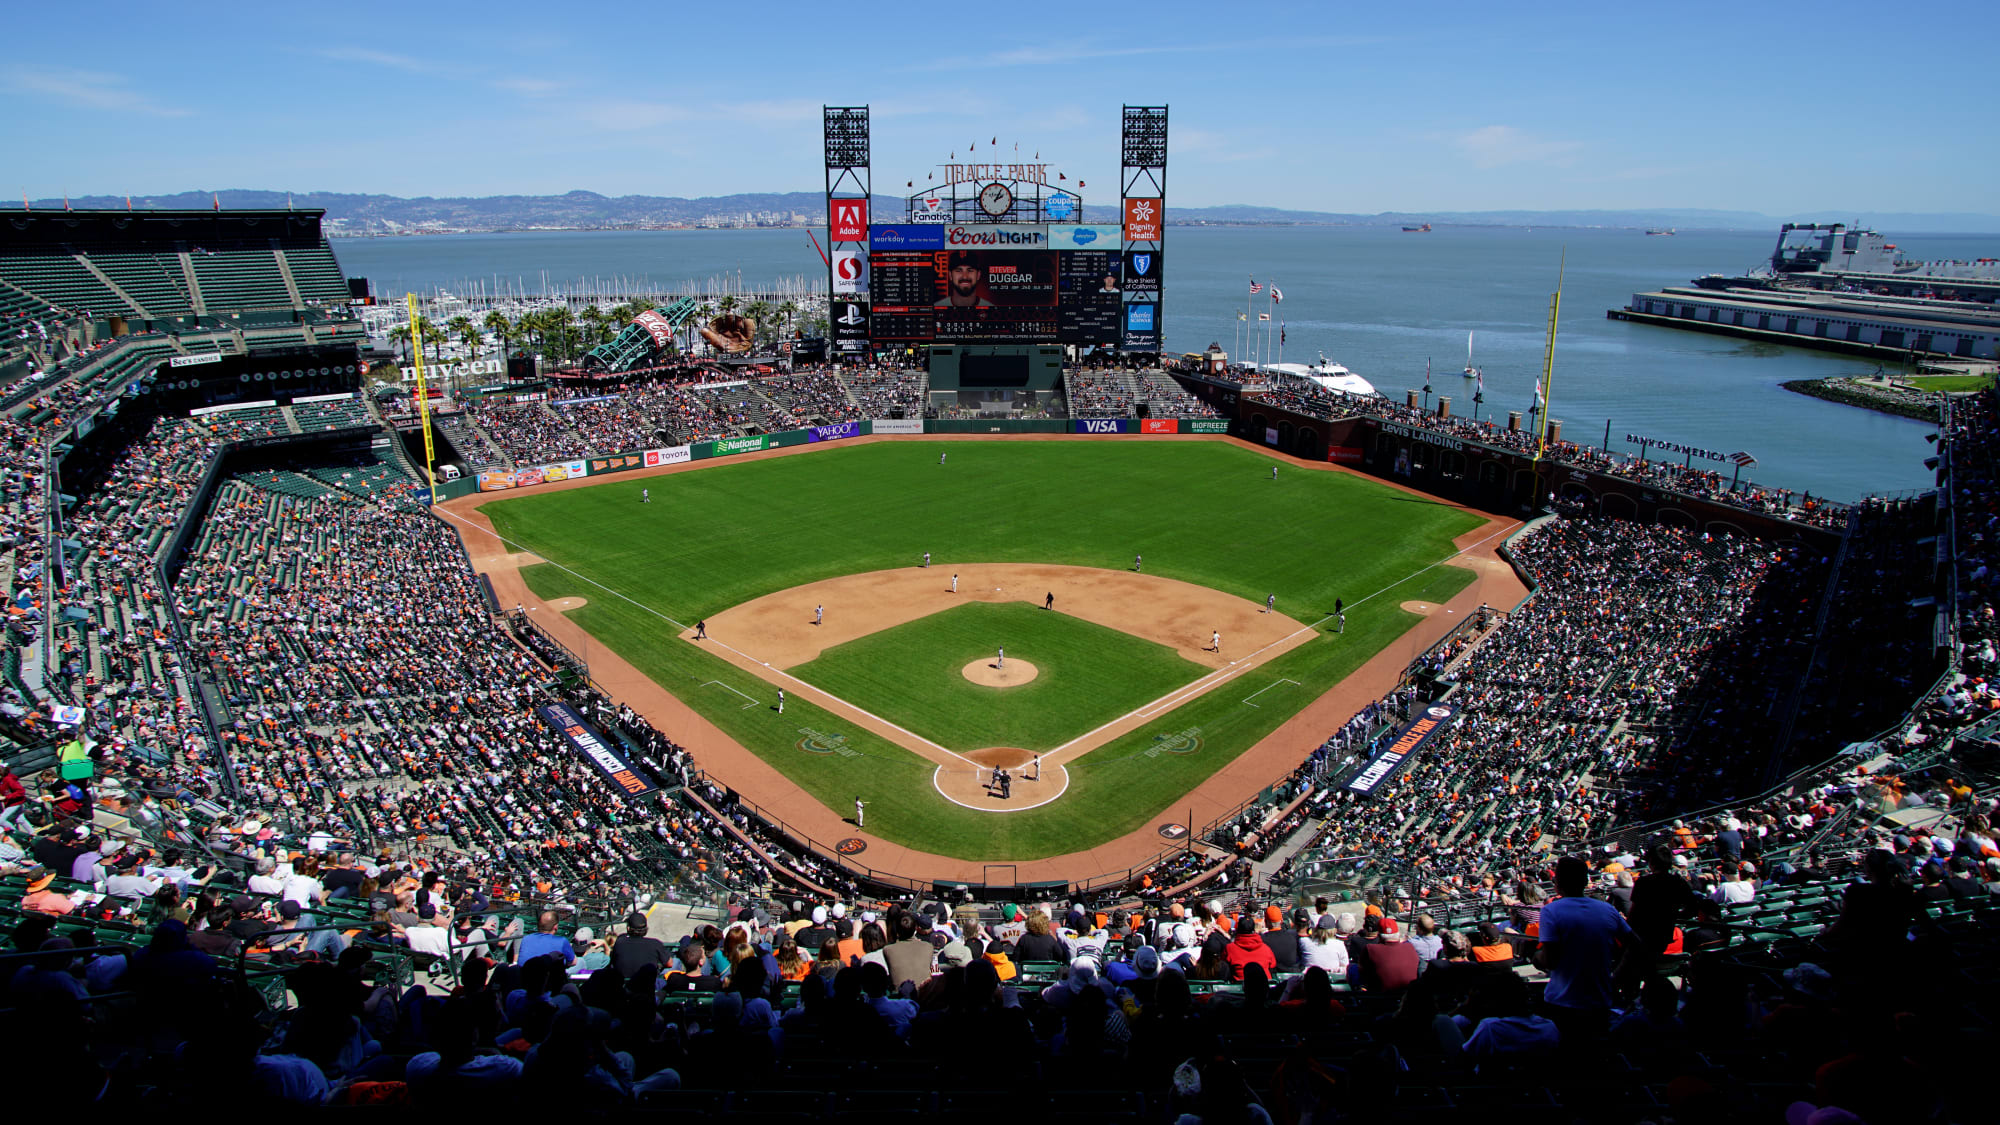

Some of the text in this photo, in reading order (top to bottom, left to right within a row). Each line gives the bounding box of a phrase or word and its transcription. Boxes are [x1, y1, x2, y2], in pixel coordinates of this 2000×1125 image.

[945, 164, 1047, 186] ORACLE PARK
[1049, 198, 1072, 206] coupa
[914, 212, 952, 221] Fanatics
[840, 227, 860, 235] Adobe
[1129, 223, 1156, 232] Dignity
[874, 235, 905, 244] workday
[949, 227, 1040, 245] Coors LIGHT
[989, 274, 1033, 283] DUGGAR
[172, 355, 219, 366] See's CANDIES
[400, 359, 503, 381] nuveen
[530, 392, 547, 401] LT
[818, 424, 851, 437] YAHOO!
[1083, 420, 1118, 433] VISA
[261, 437, 289, 446] LEXUS
[728, 436, 763, 450] National
[1411, 430, 1463, 451] LANDING
[661, 449, 689, 459] TOYOTA
[1626, 434, 1726, 463] BANK OF AMERICA
[1348, 717, 1439, 791] WELCOME TO ORACLE PARK
[572, 732, 648, 794] SAN FRANCISCO GIANTS
[1001, 929, 1021, 939] MAYS
